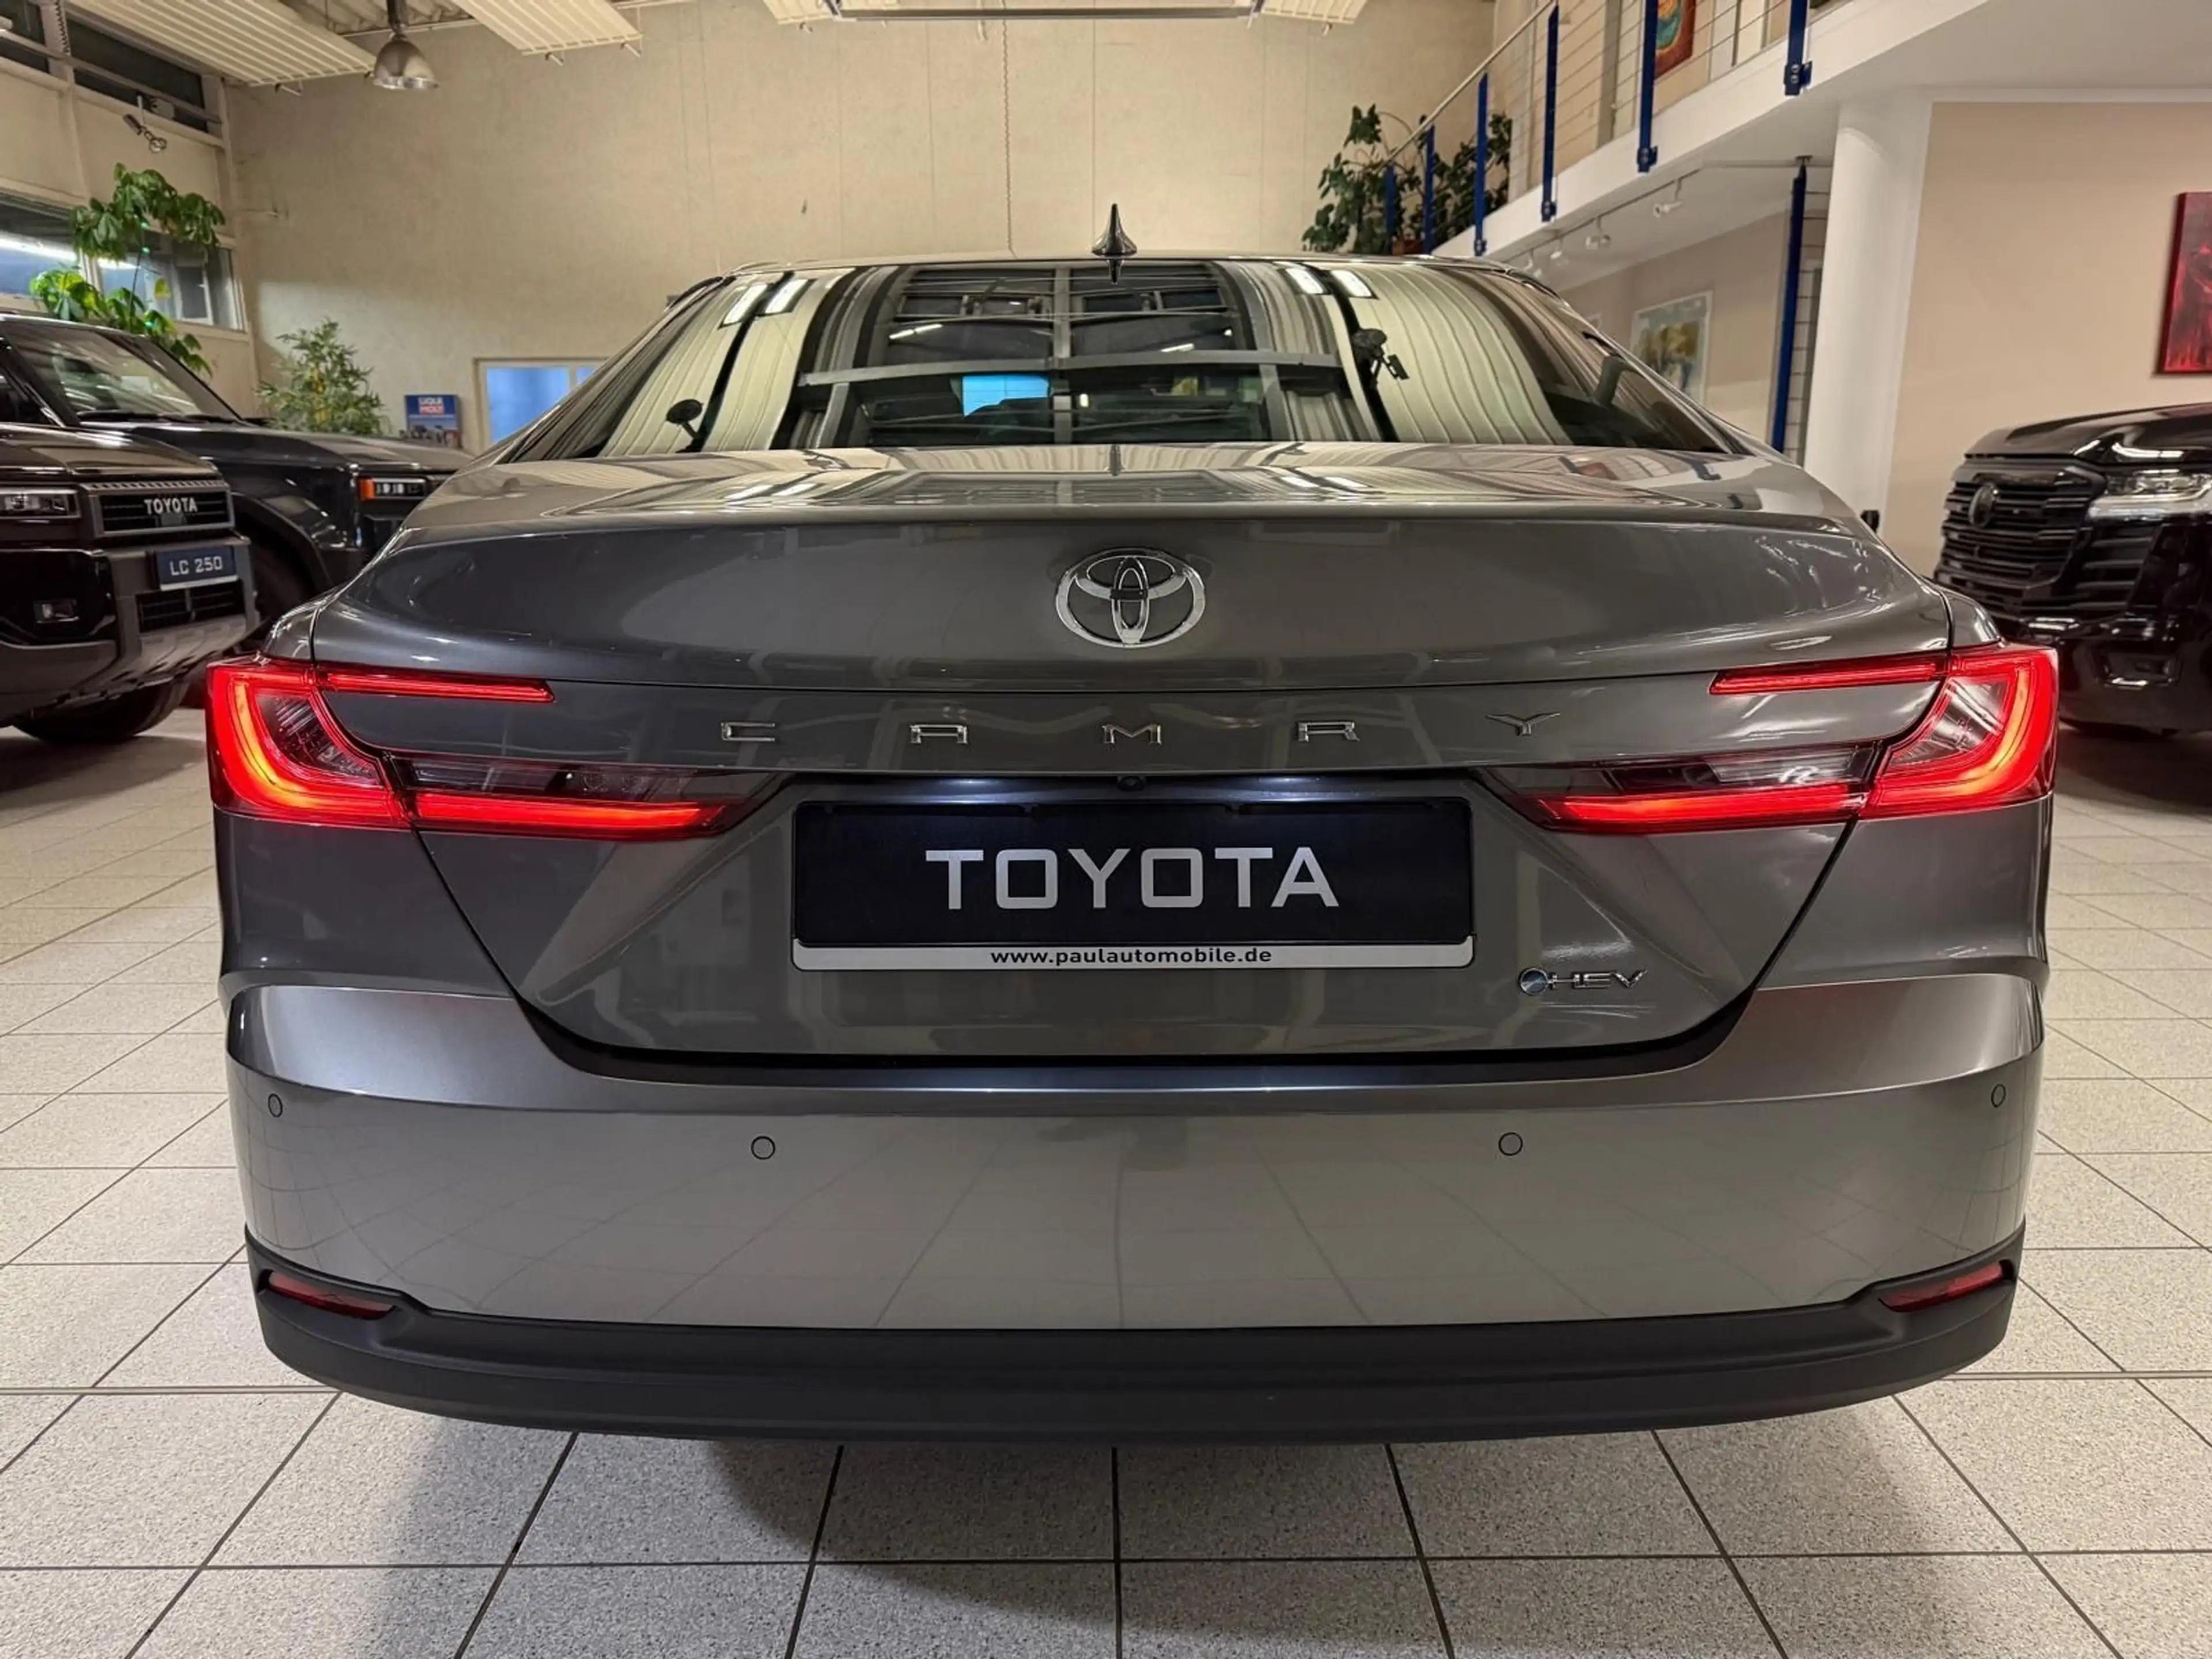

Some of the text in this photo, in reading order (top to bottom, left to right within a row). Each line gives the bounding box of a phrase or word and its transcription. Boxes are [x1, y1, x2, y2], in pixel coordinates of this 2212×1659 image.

[144, 497, 197, 515] TOYOTA
[169, 556, 223, 576] LC 250
[720, 712, 1560, 745] CAMRY
[926, 847, 1339, 910] TOYOTA
[991, 948, 1272, 966] www.paulautomobile.de
[1549, 969, 1648, 990] HEV
